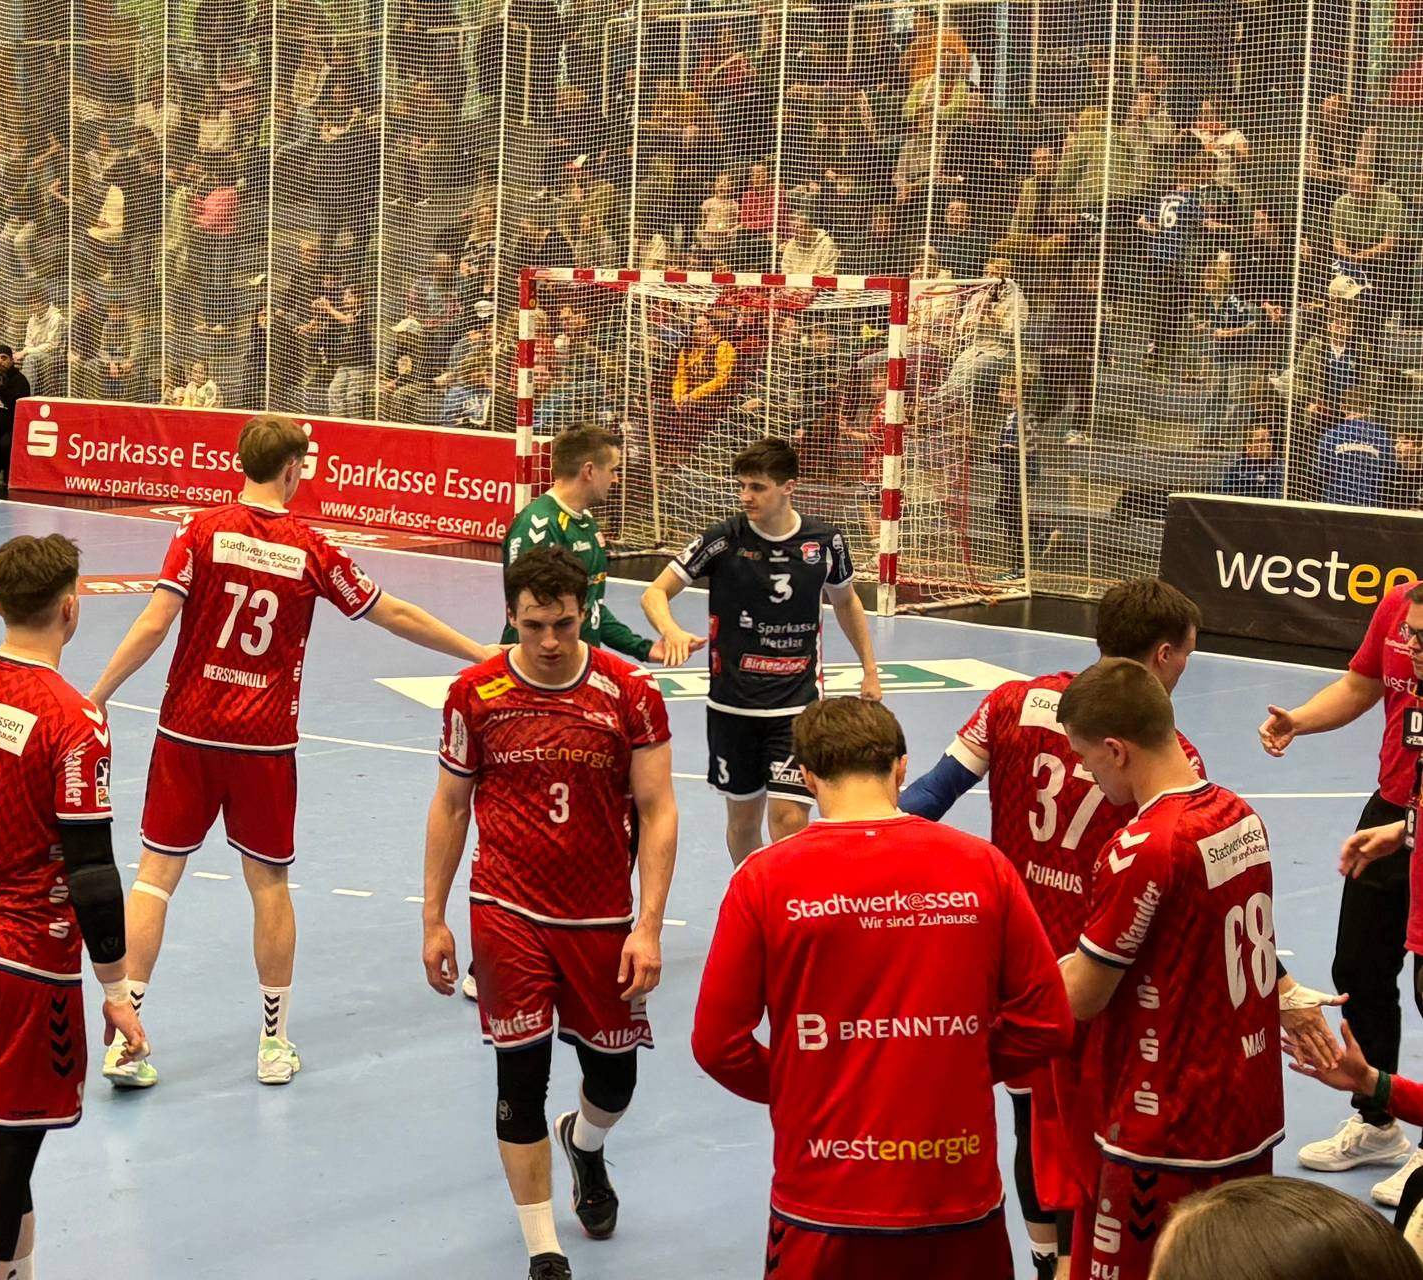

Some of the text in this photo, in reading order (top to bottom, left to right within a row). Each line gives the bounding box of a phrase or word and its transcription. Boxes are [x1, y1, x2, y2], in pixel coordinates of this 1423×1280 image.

[67, 434, 244, 474] Sparkasse Esse
[64, 473, 245, 504] www.sparkasse-essen.
[325, 454, 512, 505] Sparkasse Essen
[320, 499, 508, 541] www.sparkasse-essen.de
[768, 573, 794, 604] 3
[1215, 549, 1419, 606] westen
[216, 581, 279, 657] 73
[756, 621, 818, 636] Sparkasse
[492, 744, 616, 769] westenergie
[716, 755, 730, 785] 3
[548, 782, 570, 824] 3
[1028, 752, 1106, 850] 37
[859, 914, 883, 930] Wir
[886, 913, 915, 928] sind
[1115, 879, 1162, 953] Stauder
[839, 1014, 979, 1041] BRENNTAG
[808, 1128, 981, 1164] westenergie
